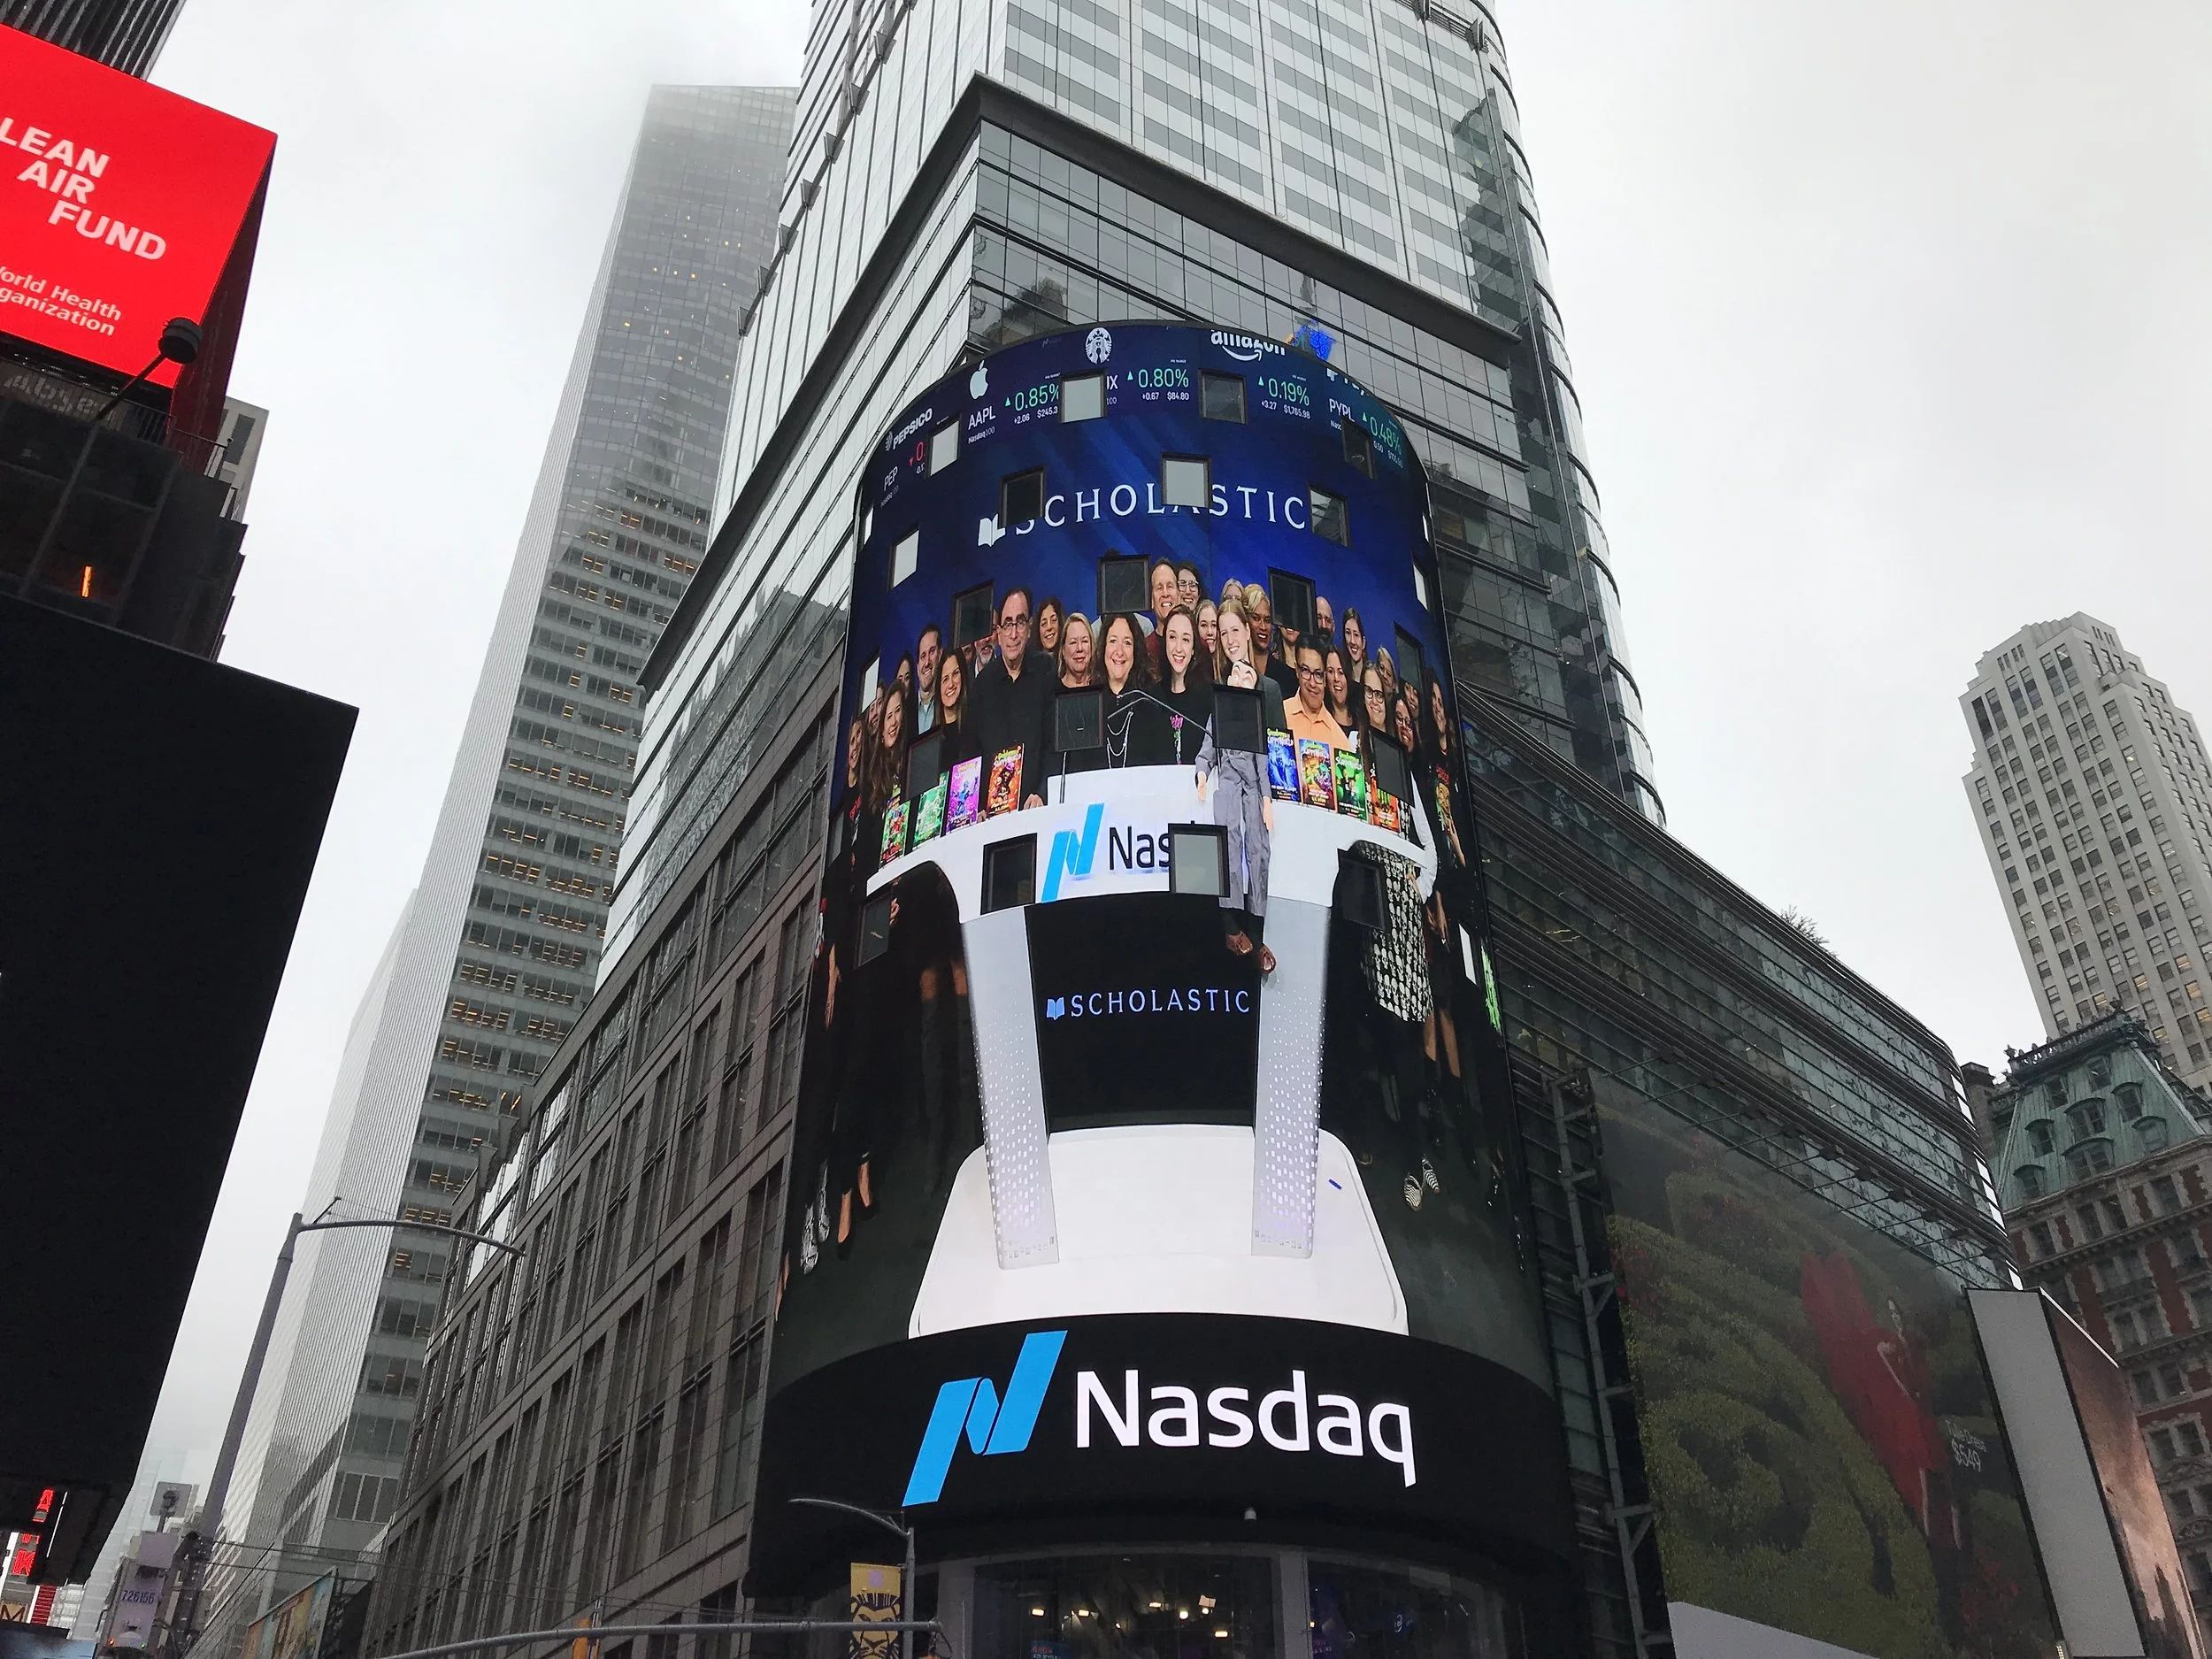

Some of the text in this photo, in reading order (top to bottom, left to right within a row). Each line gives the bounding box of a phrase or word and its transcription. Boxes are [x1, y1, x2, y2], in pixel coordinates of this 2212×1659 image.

[0, 117, 110, 179] LEAN
[16, 159, 96, 204] AIR
[48, 199, 167, 260] FUND
[0, 287, 115, 336] ganization
[50, 285, 121, 321] Health
[1138, 368, 1189, 388] 0.80%
[1268, 378, 1310, 406] 0.19%
[1015, 382, 1059, 411] 0.85%
[1142, 391, 1189, 401] +0.67 $84.80
[1261, 400, 1277, 410] +3.27
[1329, 398, 1356, 422] PYPL
[892, 408, 933, 449] PEPSICO
[968, 405, 996, 430] AAPL
[1370, 416, 1402, 455] 0.48%
[883, 466, 898, 491] PEP
[1015, 482, 1306, 535] CHOLSTIC
[1071, 988, 1250, 1018] SCHOLASTIC
[1077, 1369, 1416, 1488] Nasdaq
[1951, 1438, 1982, 1472] $549
[121, 1590, 156, 1604] 726156
